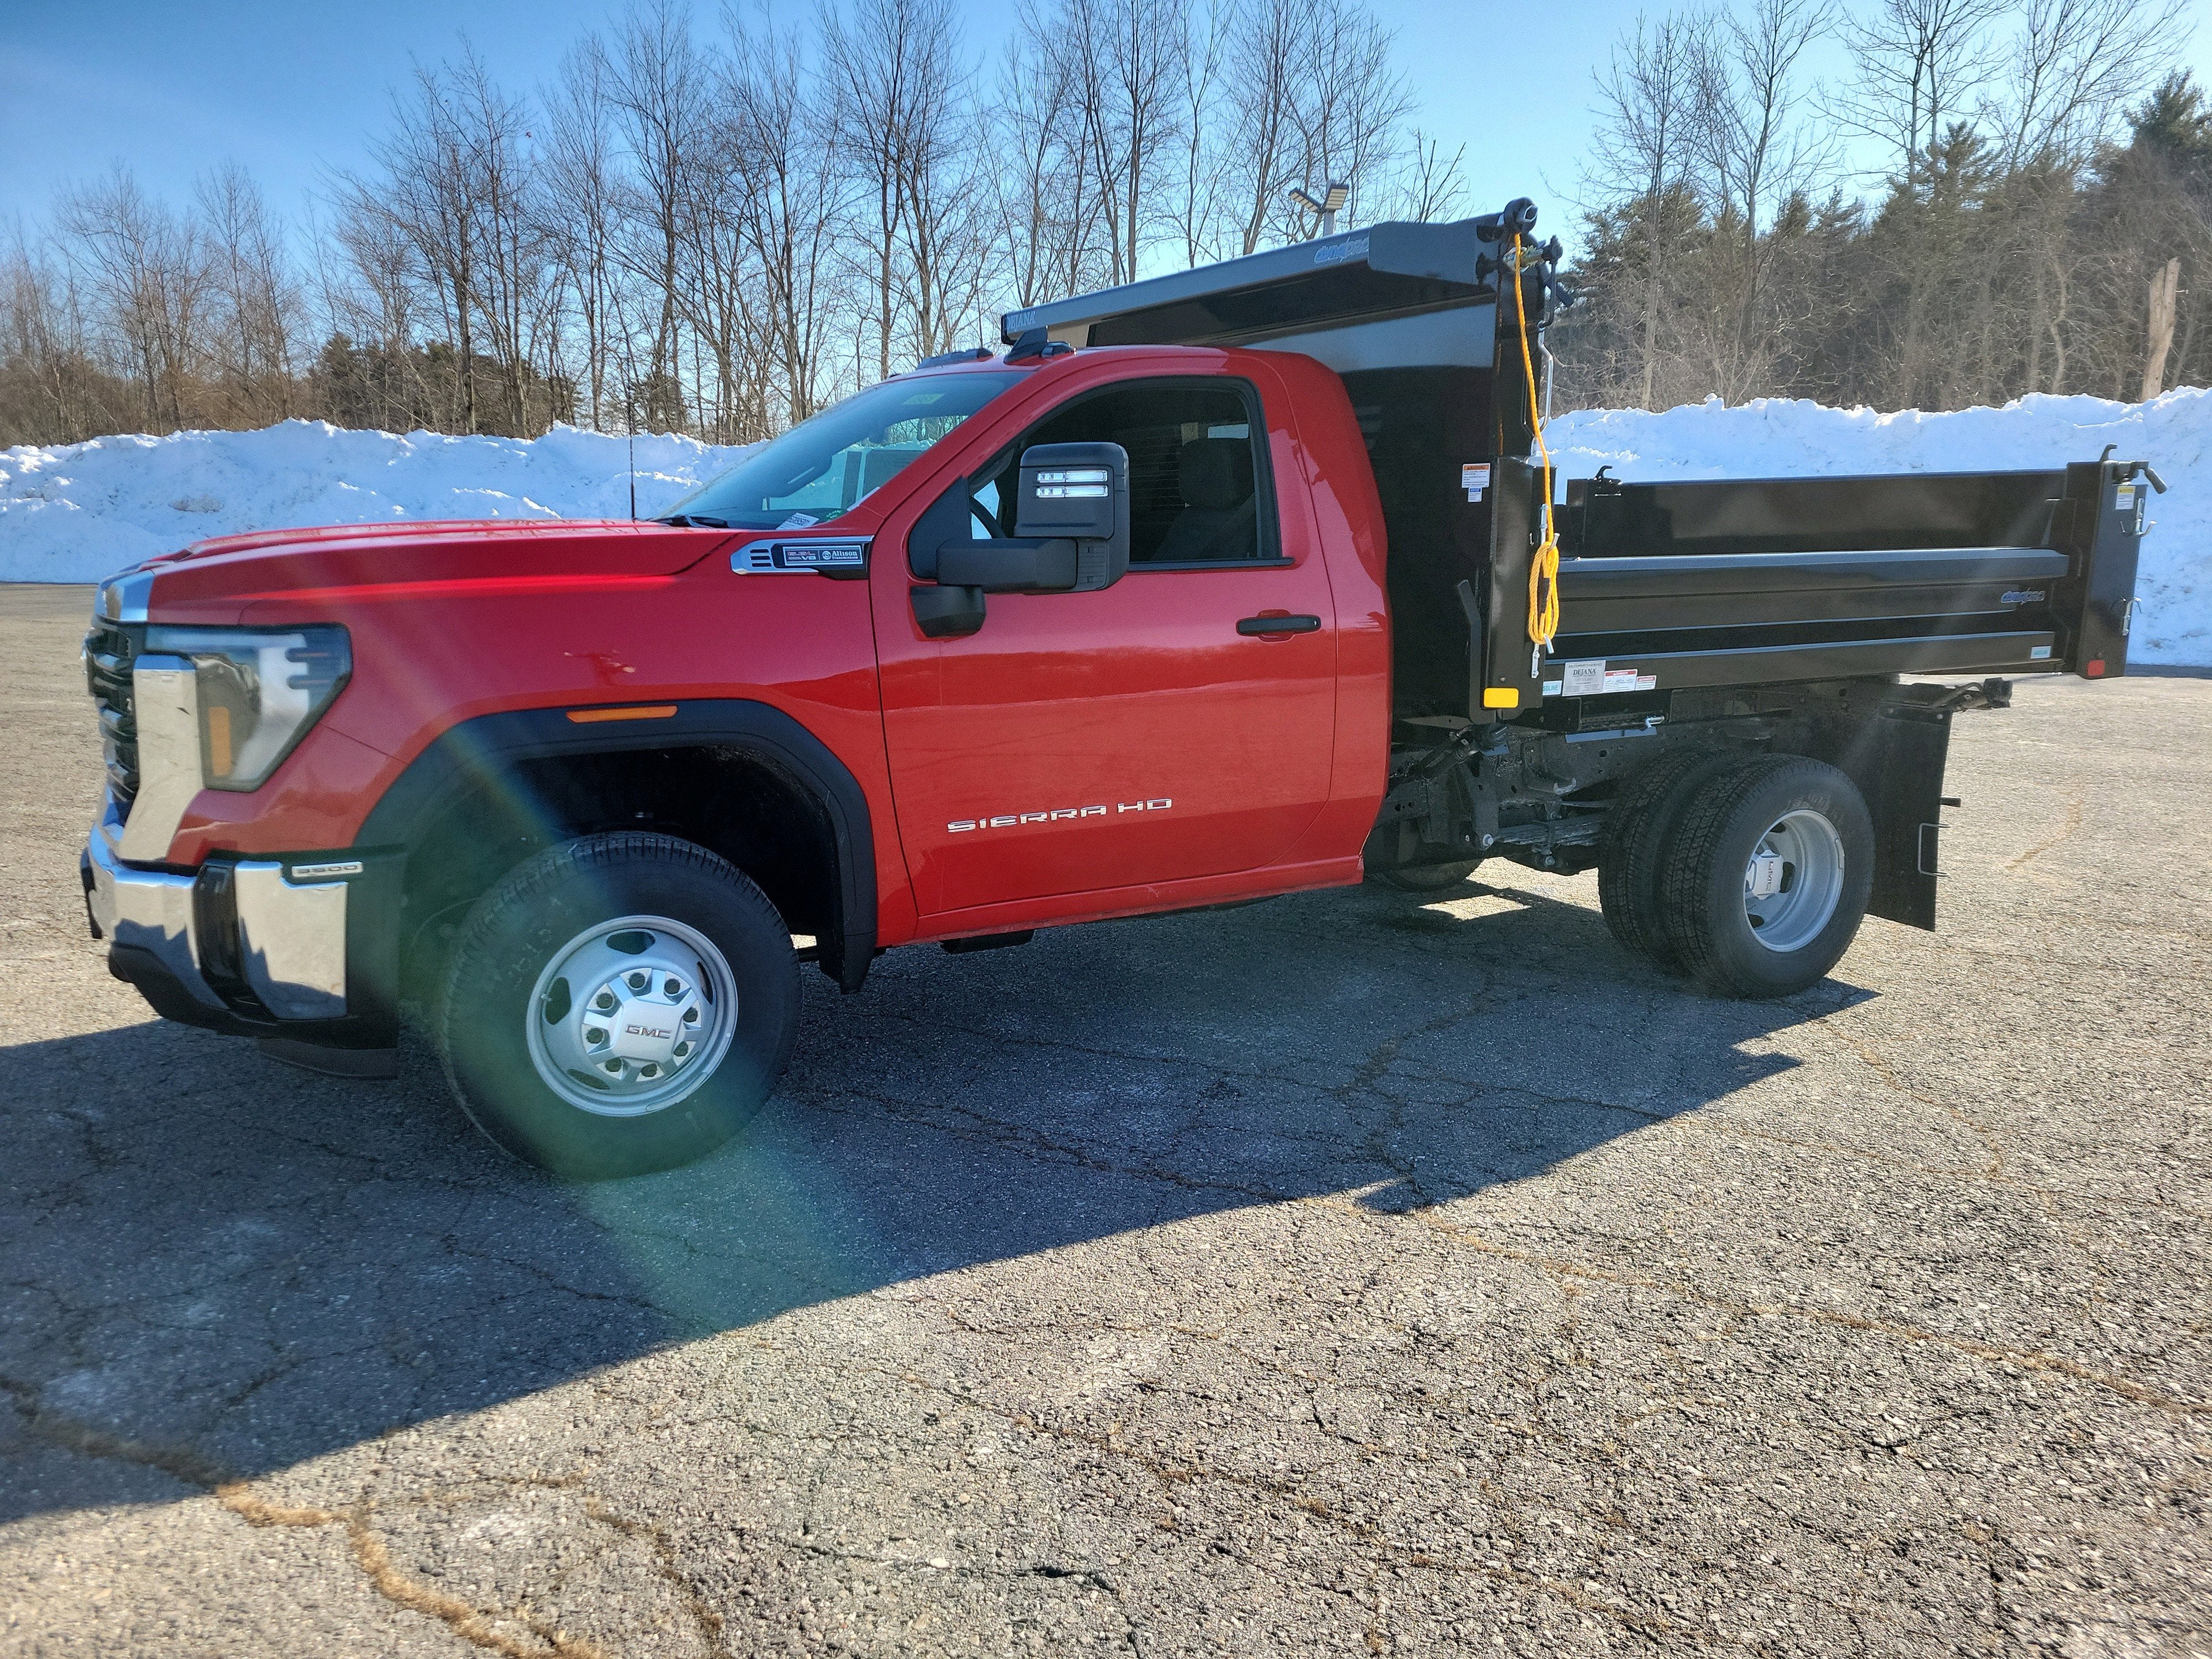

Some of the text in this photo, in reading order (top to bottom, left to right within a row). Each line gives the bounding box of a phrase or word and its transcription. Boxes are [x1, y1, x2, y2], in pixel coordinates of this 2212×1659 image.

[947, 798, 1172, 833] SIERRA HD
[625, 1023, 673, 1040] GMC
